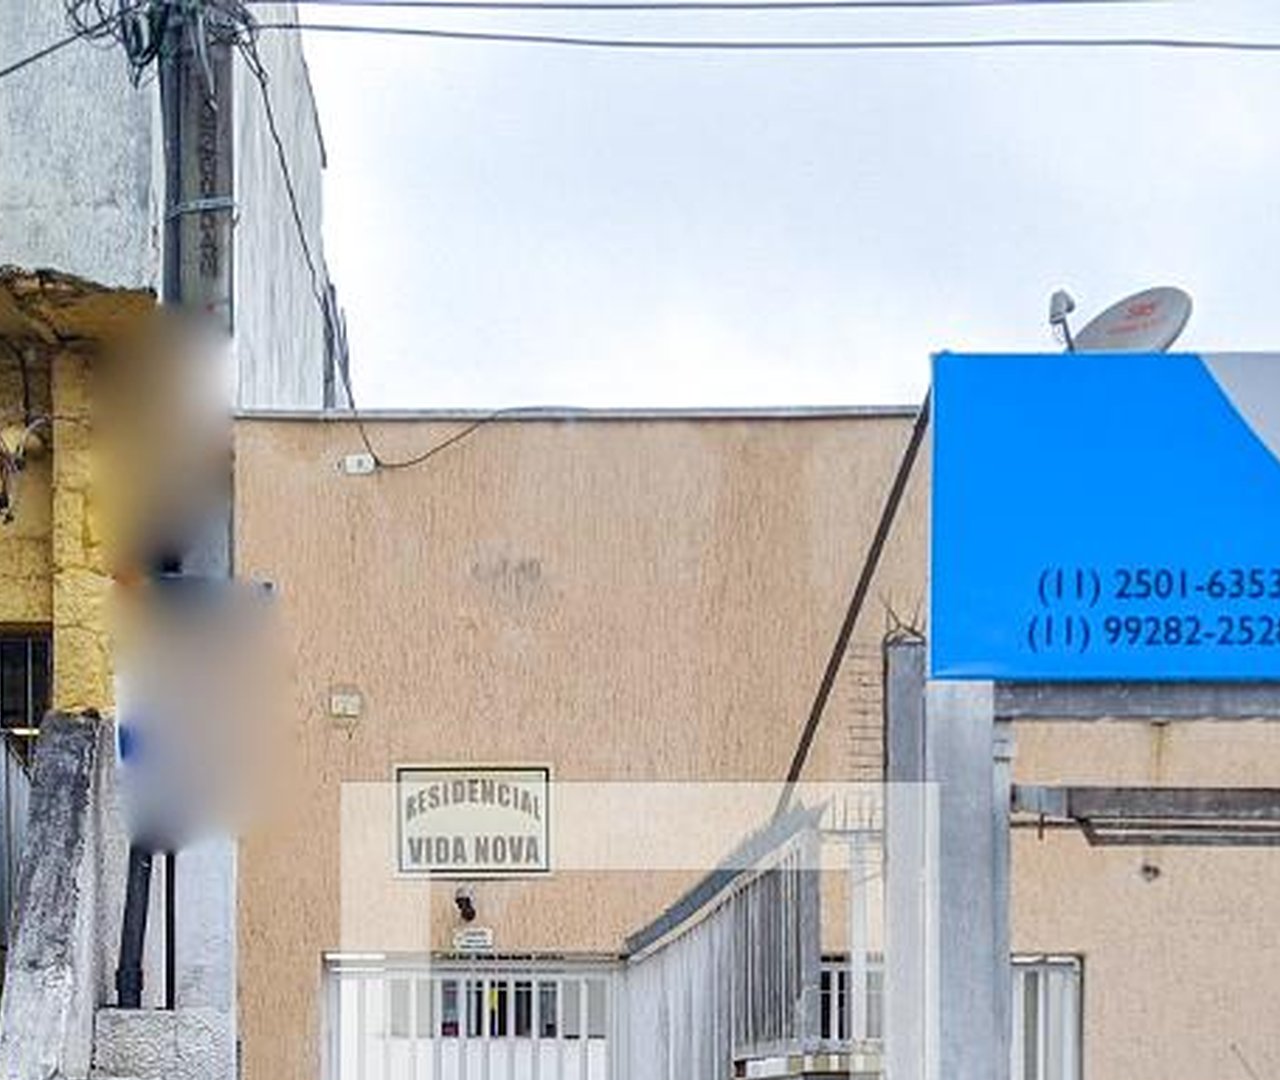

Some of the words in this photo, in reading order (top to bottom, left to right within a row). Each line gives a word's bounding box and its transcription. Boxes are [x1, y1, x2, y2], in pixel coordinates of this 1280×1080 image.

[1037, 569, 1102, 606] (11)
[1026, 615, 1091, 654] (11)
[405, 778, 541, 822] RESIDENCIAL
[408, 836, 468, 864] VIDA
[474, 836, 540, 864] NOVA
